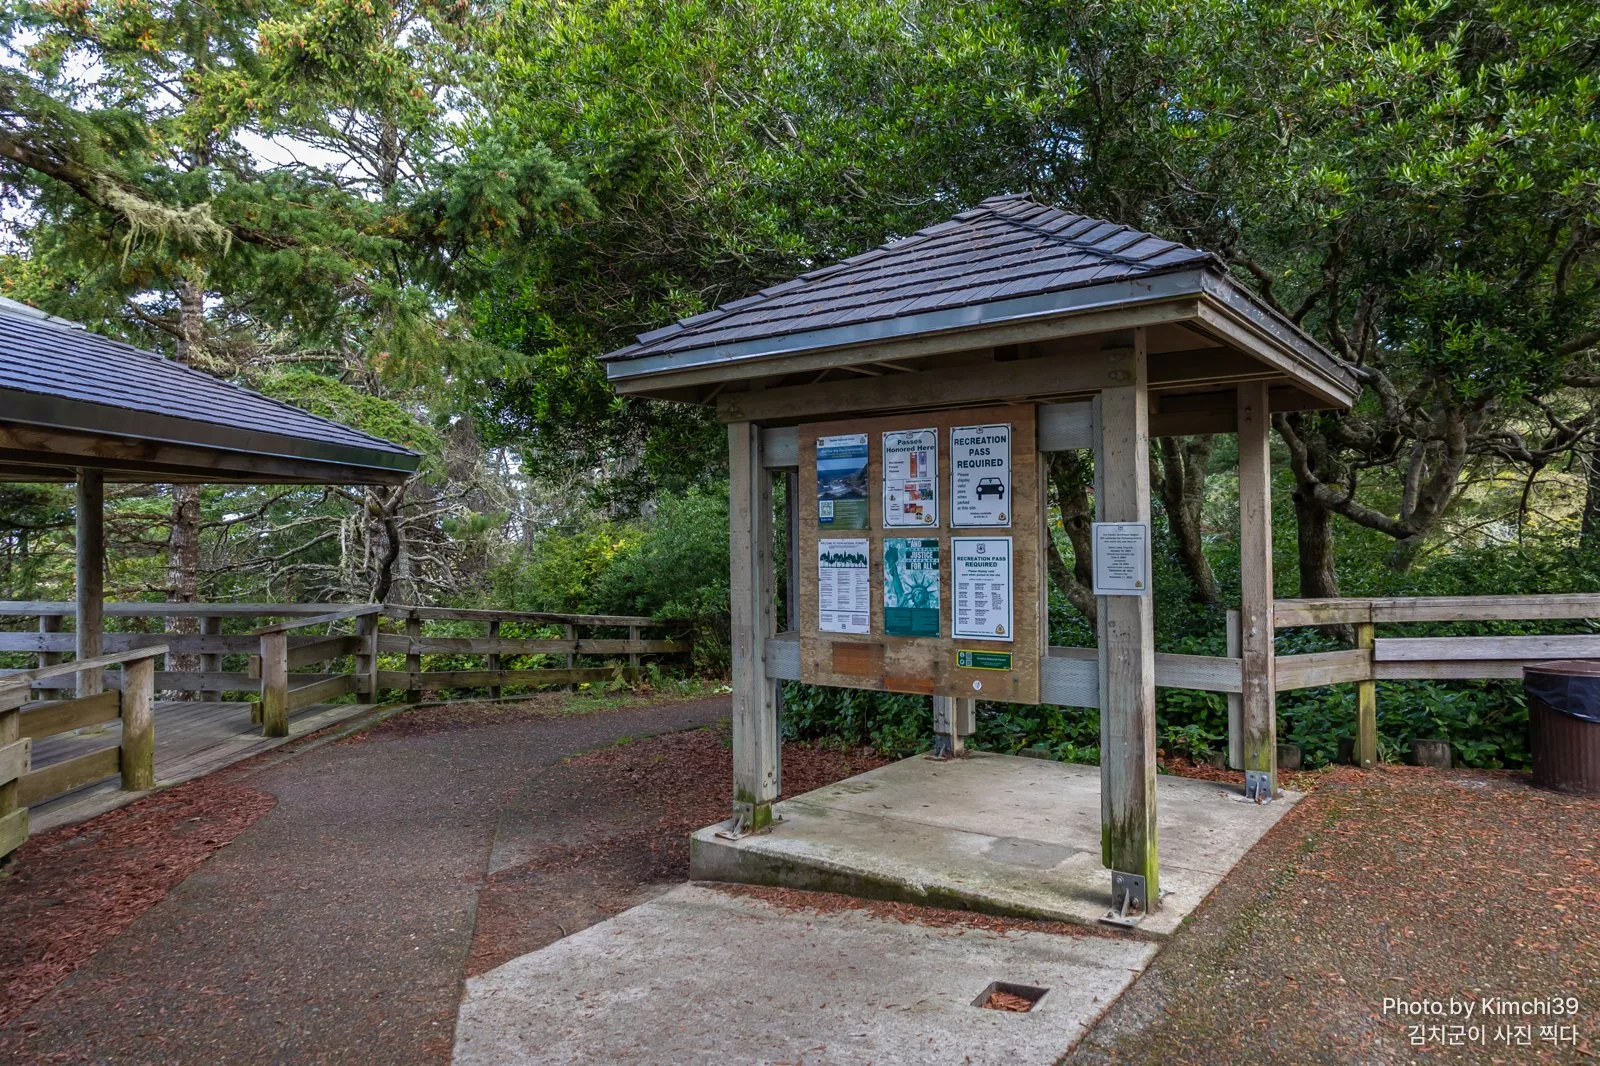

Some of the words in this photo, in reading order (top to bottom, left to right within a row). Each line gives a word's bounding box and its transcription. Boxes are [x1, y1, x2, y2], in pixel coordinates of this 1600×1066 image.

[953, 435, 1007, 446] RECREATION
[886, 445, 916, 453] Honored
[968, 447, 991, 457] PASS
[957, 458, 1004, 469] REQUIRED
[910, 551, 933, 559] JUSTICE
